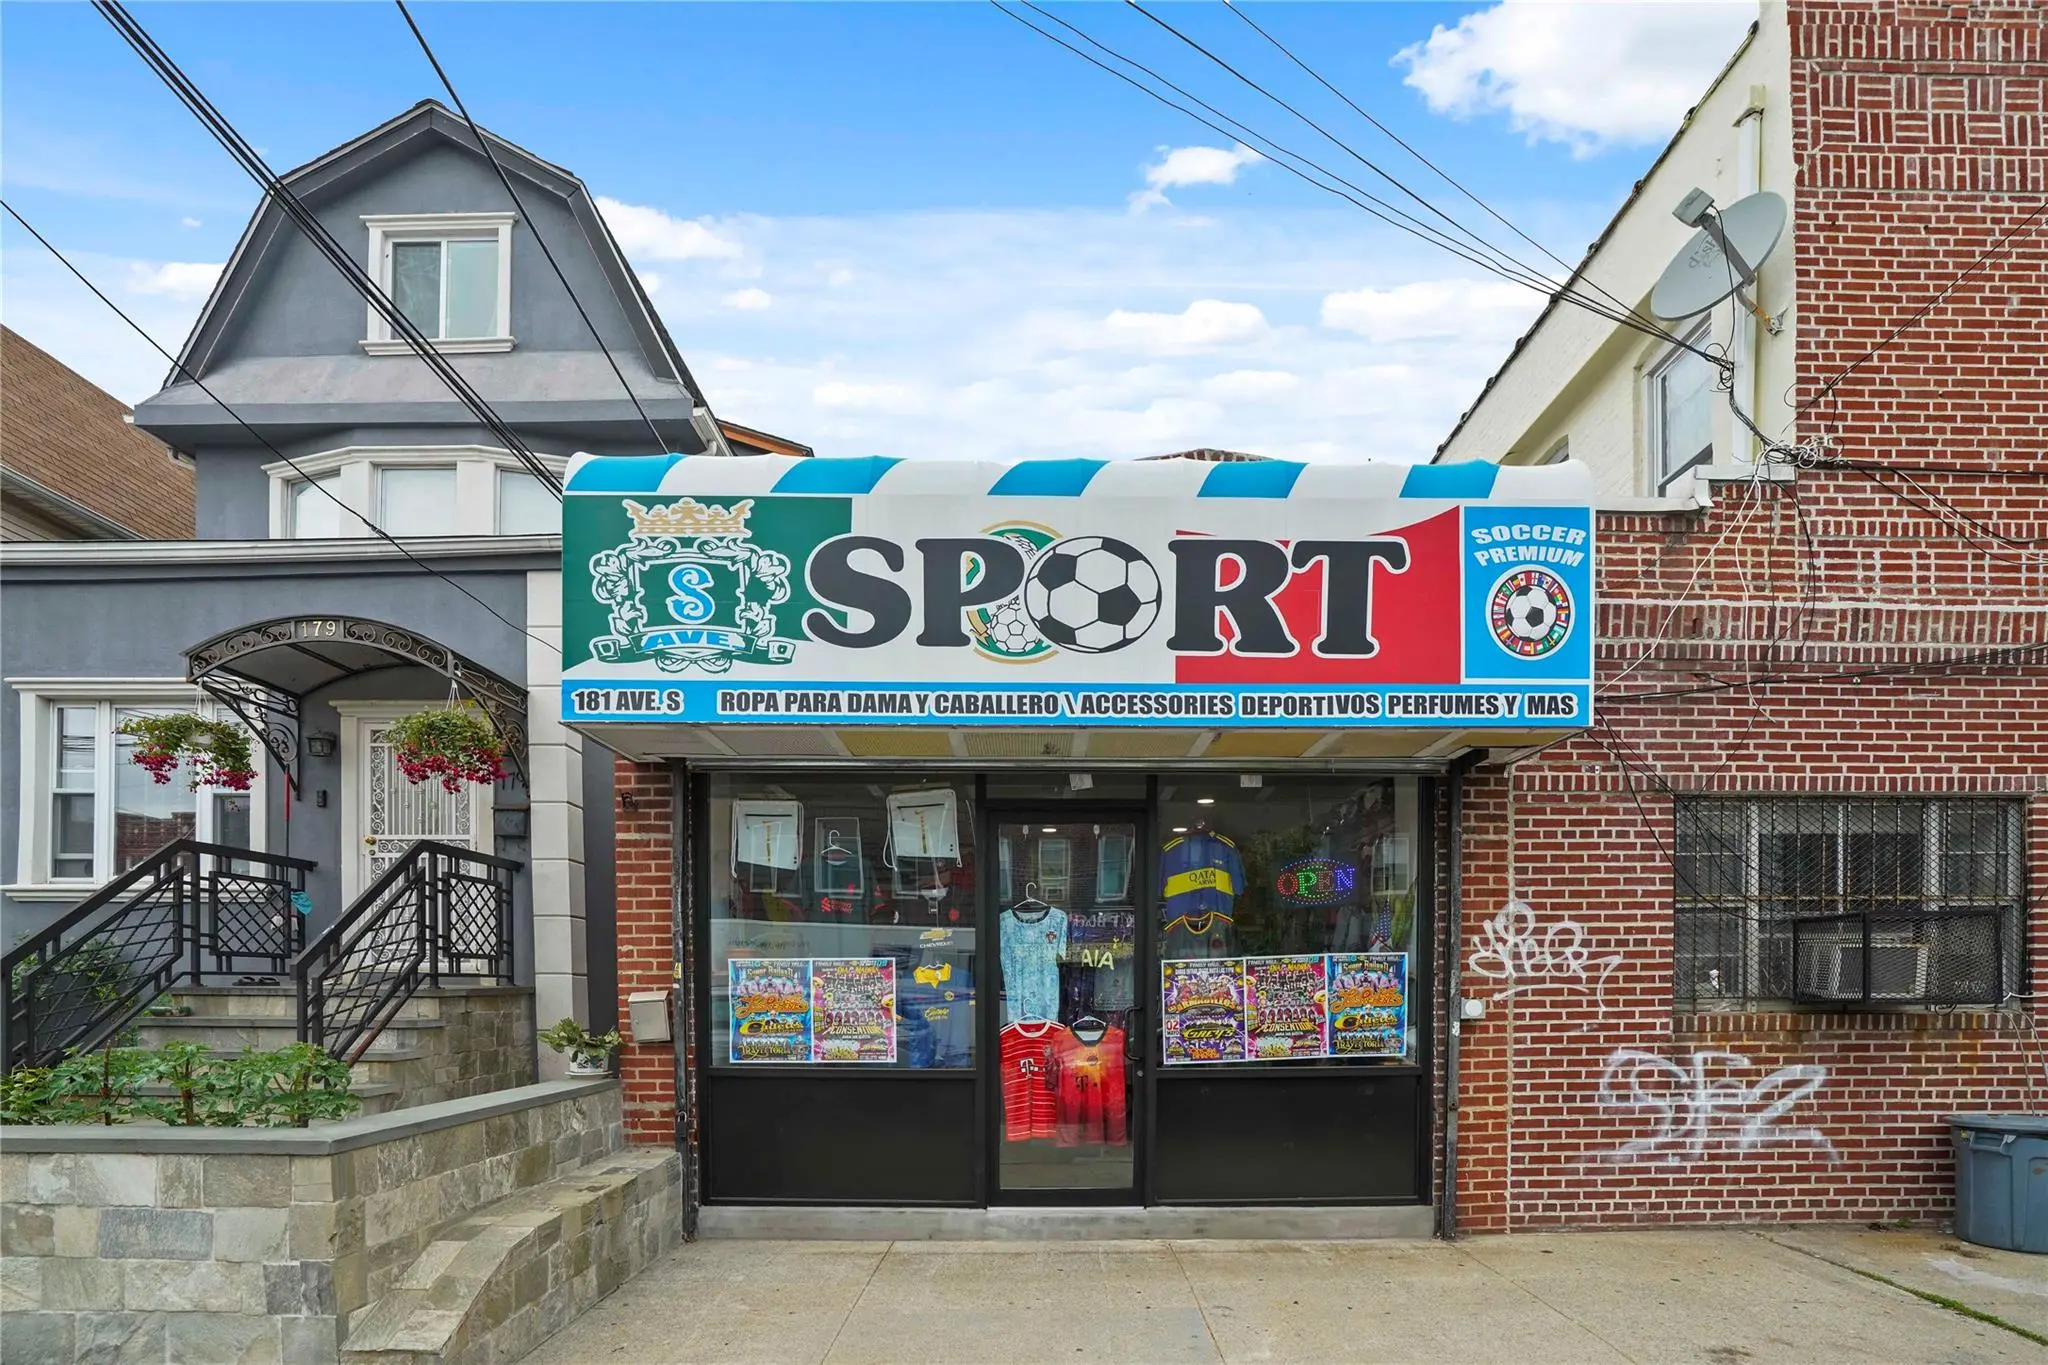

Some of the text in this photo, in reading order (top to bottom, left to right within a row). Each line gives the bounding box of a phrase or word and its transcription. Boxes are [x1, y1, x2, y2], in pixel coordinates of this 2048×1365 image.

[1471, 524, 1587, 545] SOCCER
[1473, 546, 1585, 567] PREMIUM
[671, 566, 714, 622] S
[807, 535, 1408, 654] SPORT
[302, 621, 336, 637] 179
[575, 691, 681, 711] 181 AVE. S
[721, 692, 780, 712] ROPA
[784, 692, 842, 712] PARA
[851, 693, 914, 713] DAMA
[915, 693, 929, 713] Y
[934, 693, 1059, 714] CABALLERO
[1080, 694, 1233, 715] ACCESSORIES
[1242, 694, 1379, 715] DEPORTIVOS
[1388, 695, 1499, 715] PERFUMES
[1504, 695, 1517, 715] Y
[1527, 695, 1574, 715] MAS
[1189, 870, 1217, 883] QATA
[1277, 868, 1355, 896] OPEN
[1081, 948, 1115, 970] AIA
[1166, 1021, 1179, 1031] 02
